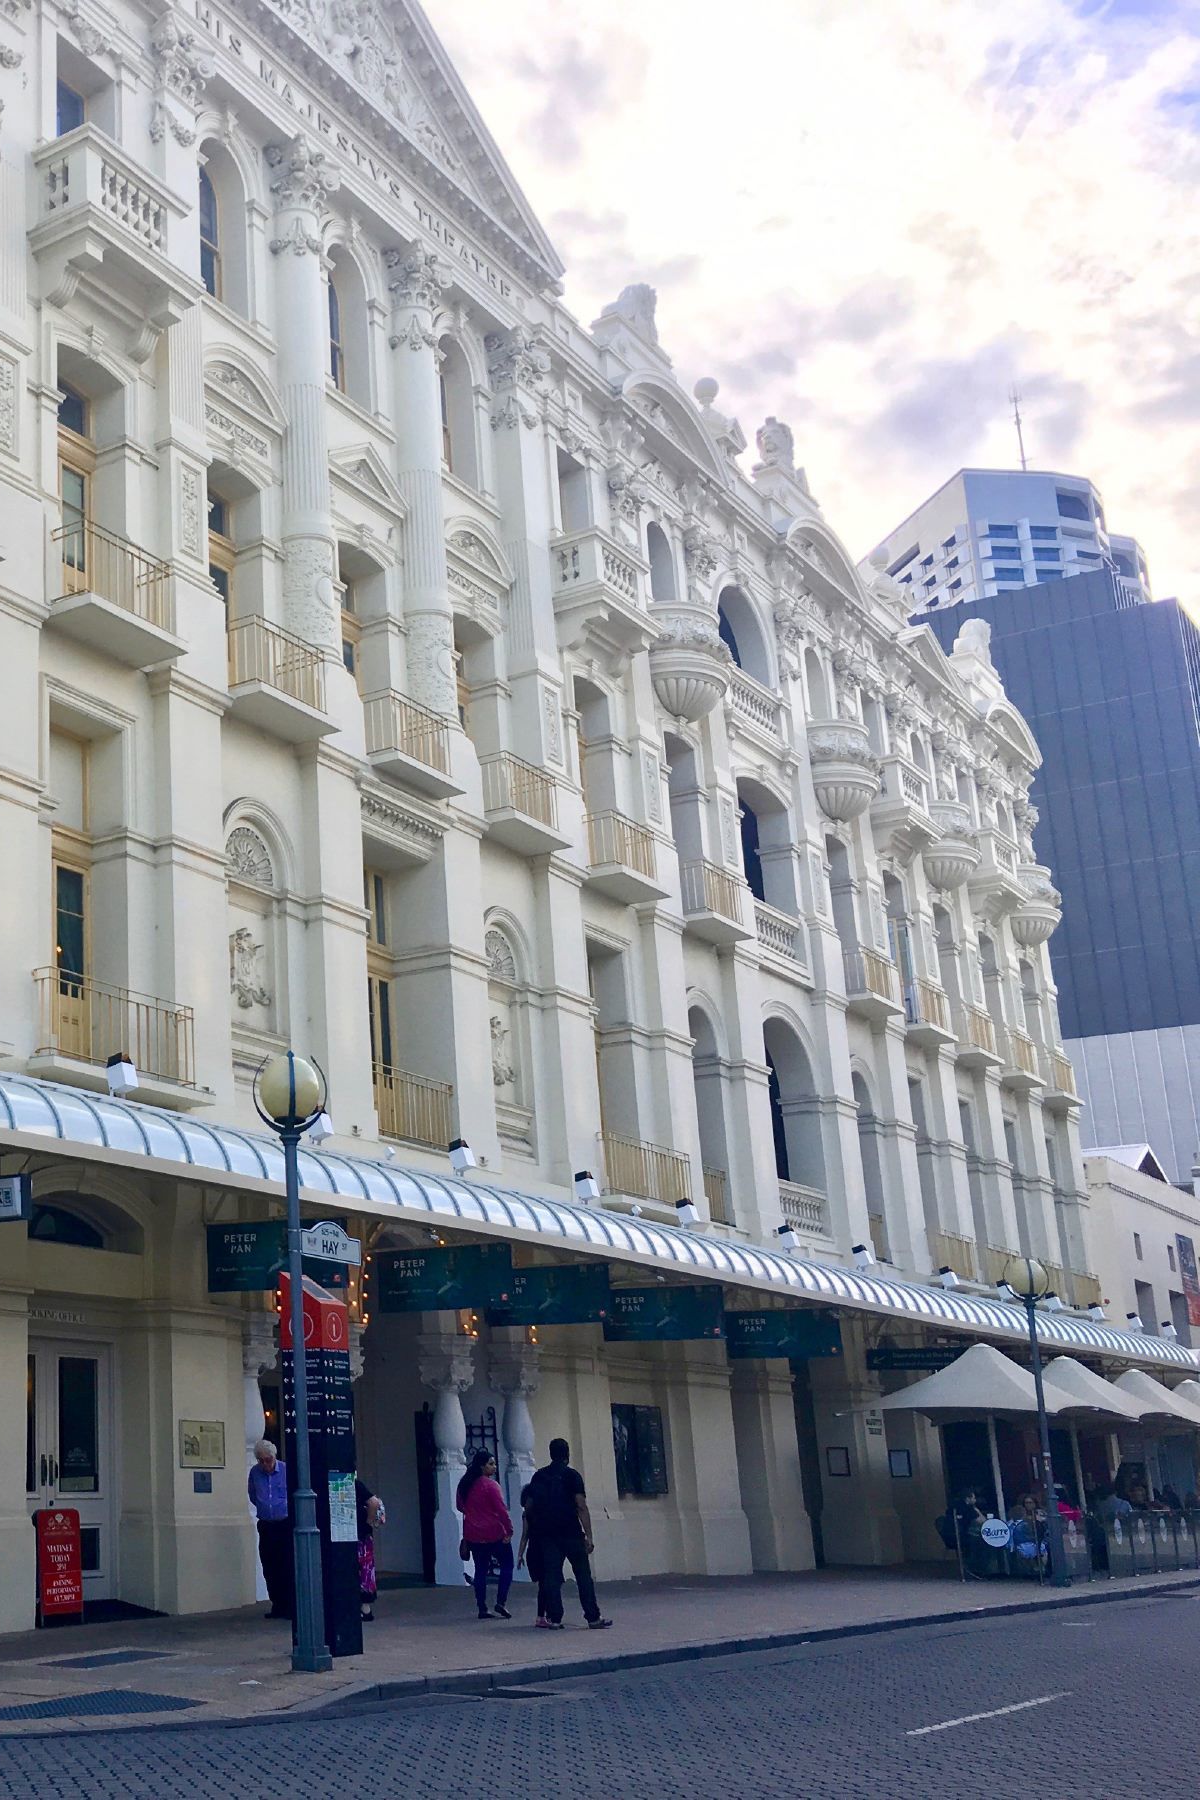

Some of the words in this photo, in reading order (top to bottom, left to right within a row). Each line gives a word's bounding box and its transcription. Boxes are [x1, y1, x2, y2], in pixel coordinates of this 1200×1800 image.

[195, 0, 242, 55] HIS
[259, 59, 401, 199] MAJESTY'S
[413, 200, 512, 297] THEATRE
[224, 1233, 257, 1243] PETER
[230, 1244, 251, 1254] PAN
[322, 1239, 339, 1255] HAY
[393, 1258, 425, 1269] PETER
[400, 1268, 420, 1278] PAN
[615, 1296, 645, 1304] PETER
[622, 1304, 640, 1313] PAN
[738, 1318, 766, 1326] PETER
[744, 1325, 762, 1333] PAN
[47, 1544, 73, 1552] MATINEE
[50, 1554, 70, 1563] TODAY
[53, 1579, 73, 1587] EVENING
[46, 1585, 80, 1595] PERFORMANCE
